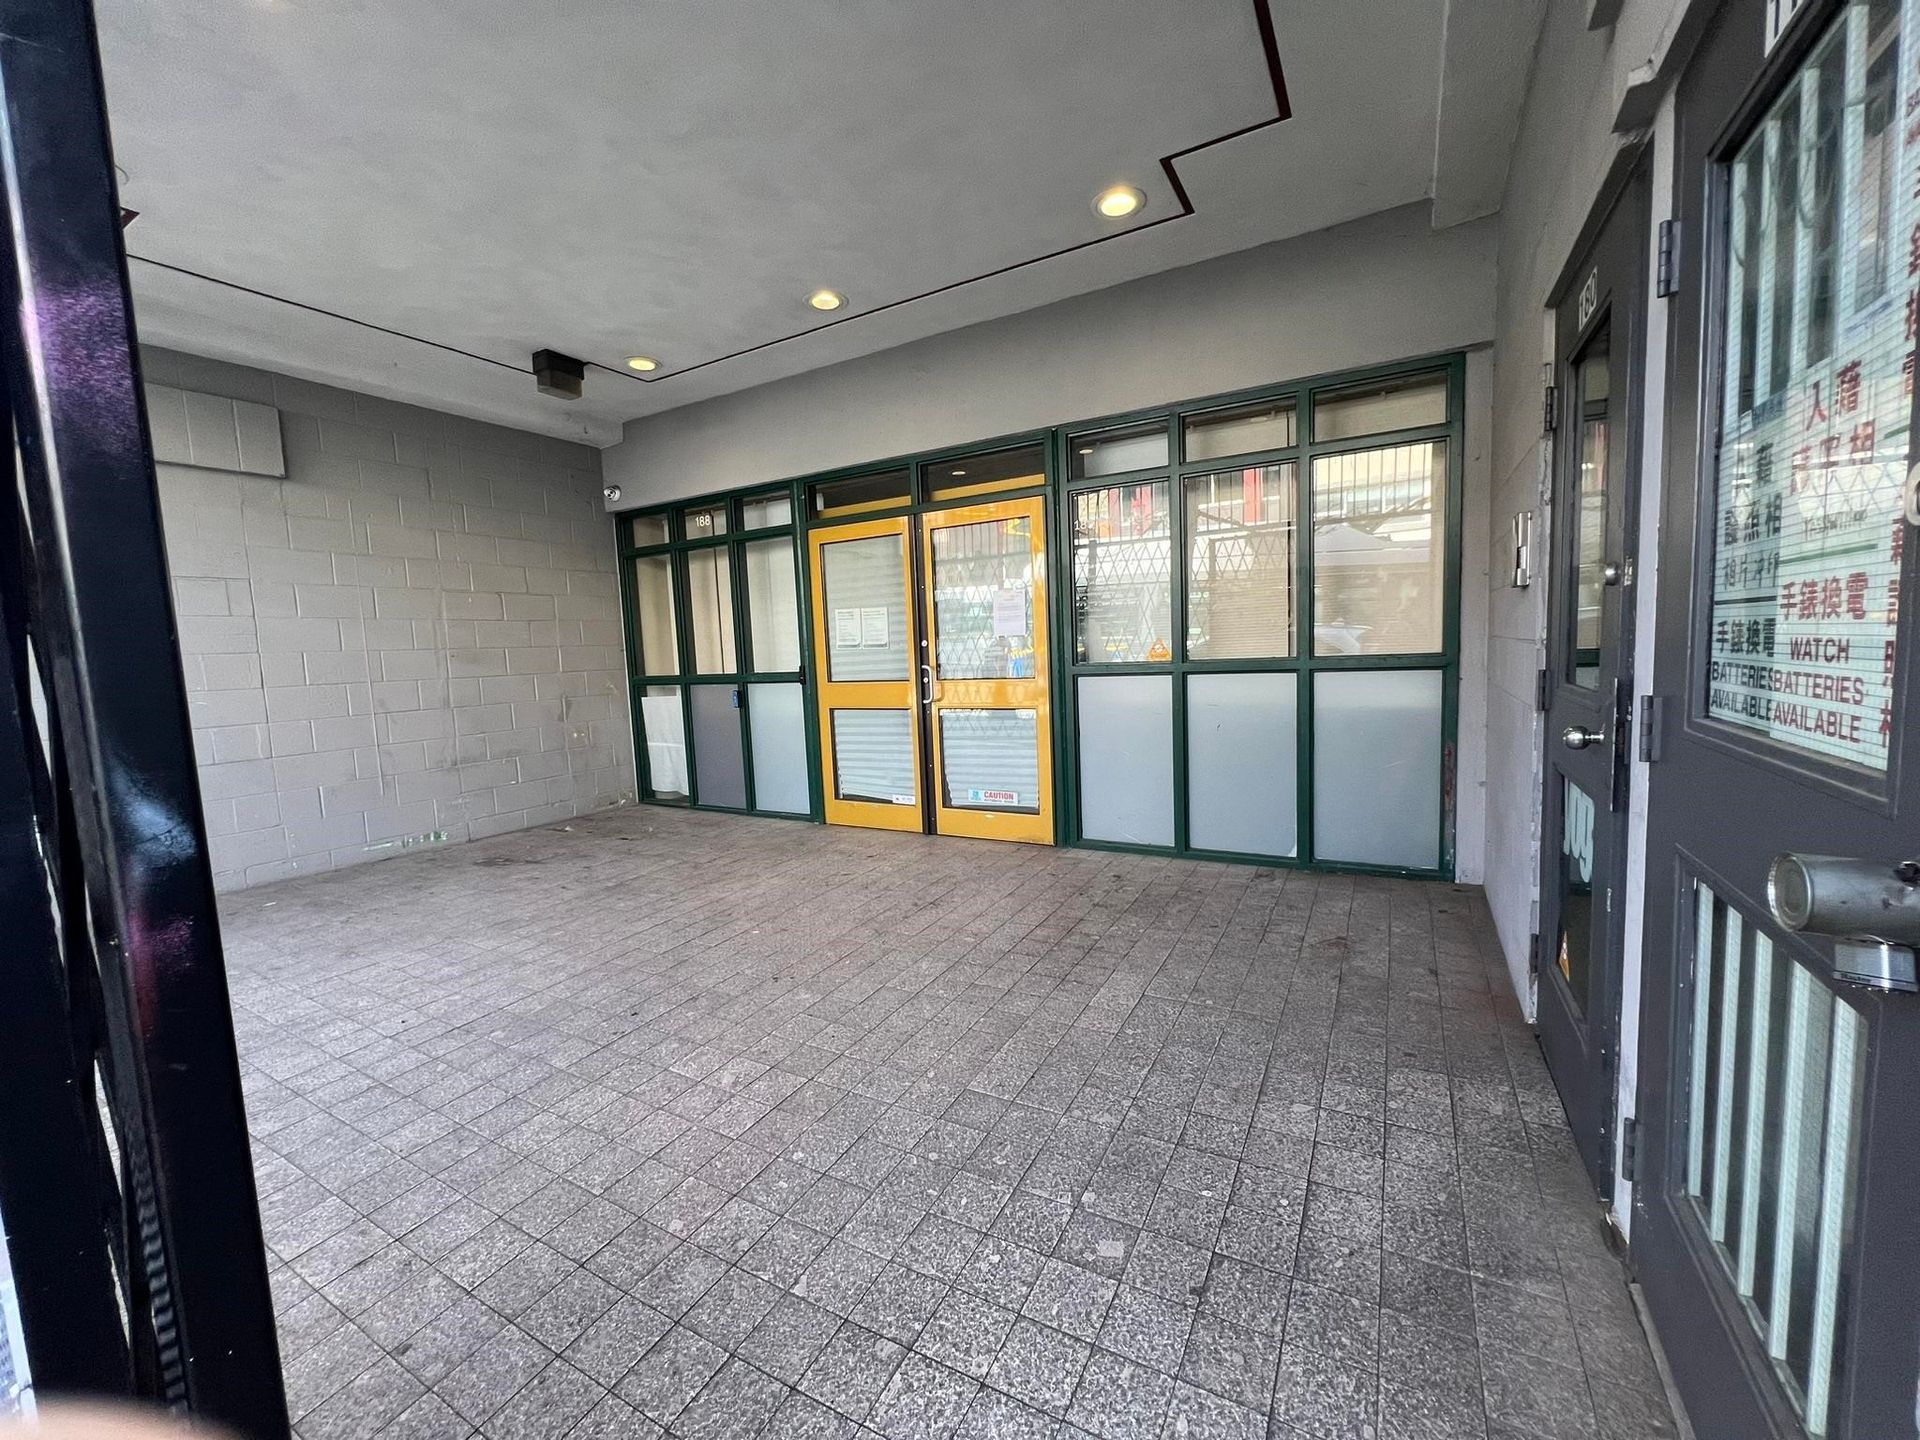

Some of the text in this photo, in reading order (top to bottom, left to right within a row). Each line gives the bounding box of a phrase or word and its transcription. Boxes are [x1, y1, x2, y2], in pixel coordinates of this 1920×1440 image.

[695, 515, 711, 527] 188
[1790, 637, 1849, 663] WATCH
[1711, 661, 1773, 691] BATTERIES
[1773, 669, 1864, 705] BATTERIES
[1710, 689, 1771, 721] AVAILABLE
[1773, 702, 1862, 743] AVAILABLE
[984, 791, 1014, 801] CAUTION
